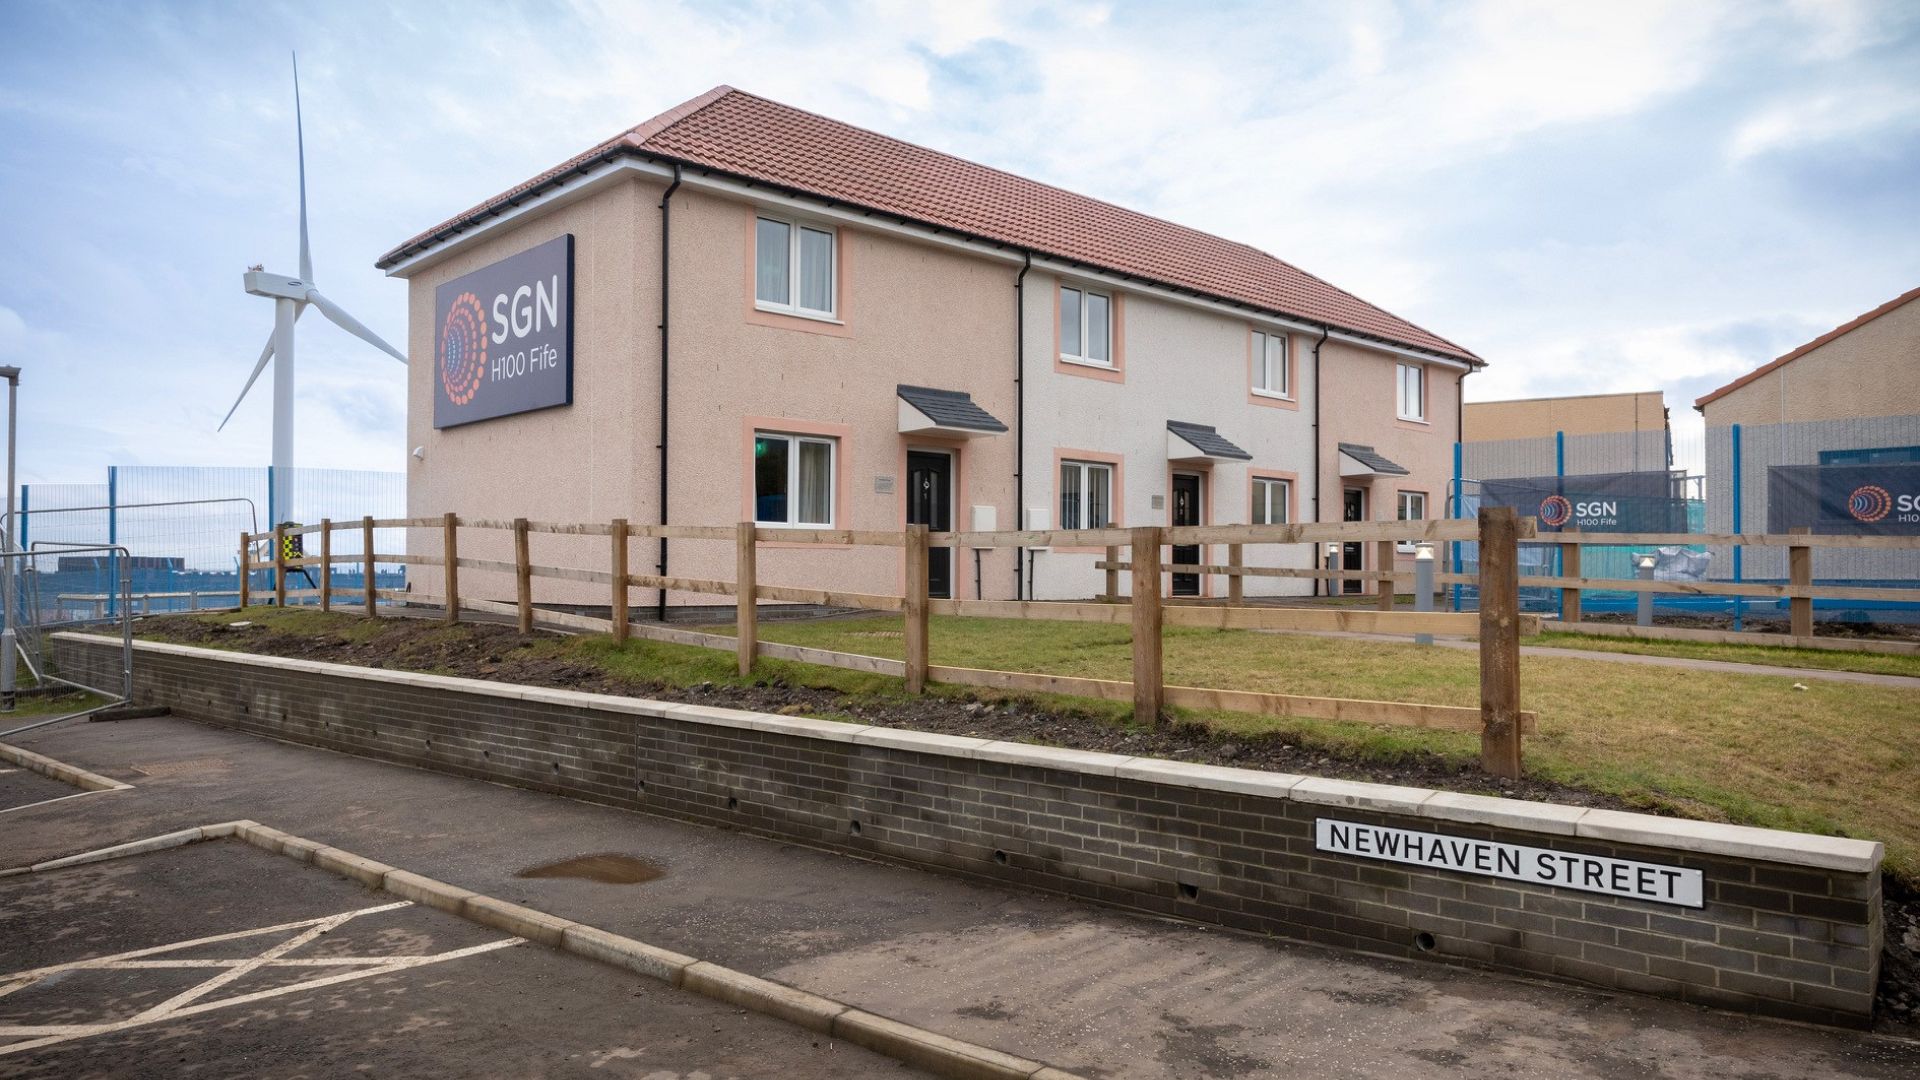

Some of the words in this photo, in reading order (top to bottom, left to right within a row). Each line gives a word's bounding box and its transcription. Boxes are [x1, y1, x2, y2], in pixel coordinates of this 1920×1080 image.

[491, 275, 558, 344] SGN
[491, 351, 525, 383] H100
[530, 344, 558, 373] Fife
[1575, 501, 1617, 517] SGN
[1576, 518, 1599, 526] H100
[1600, 518, 1617, 526] Fife
[1330, 824, 1520, 875] NEWHAVEN
[1536, 853, 1682, 899] STREET
